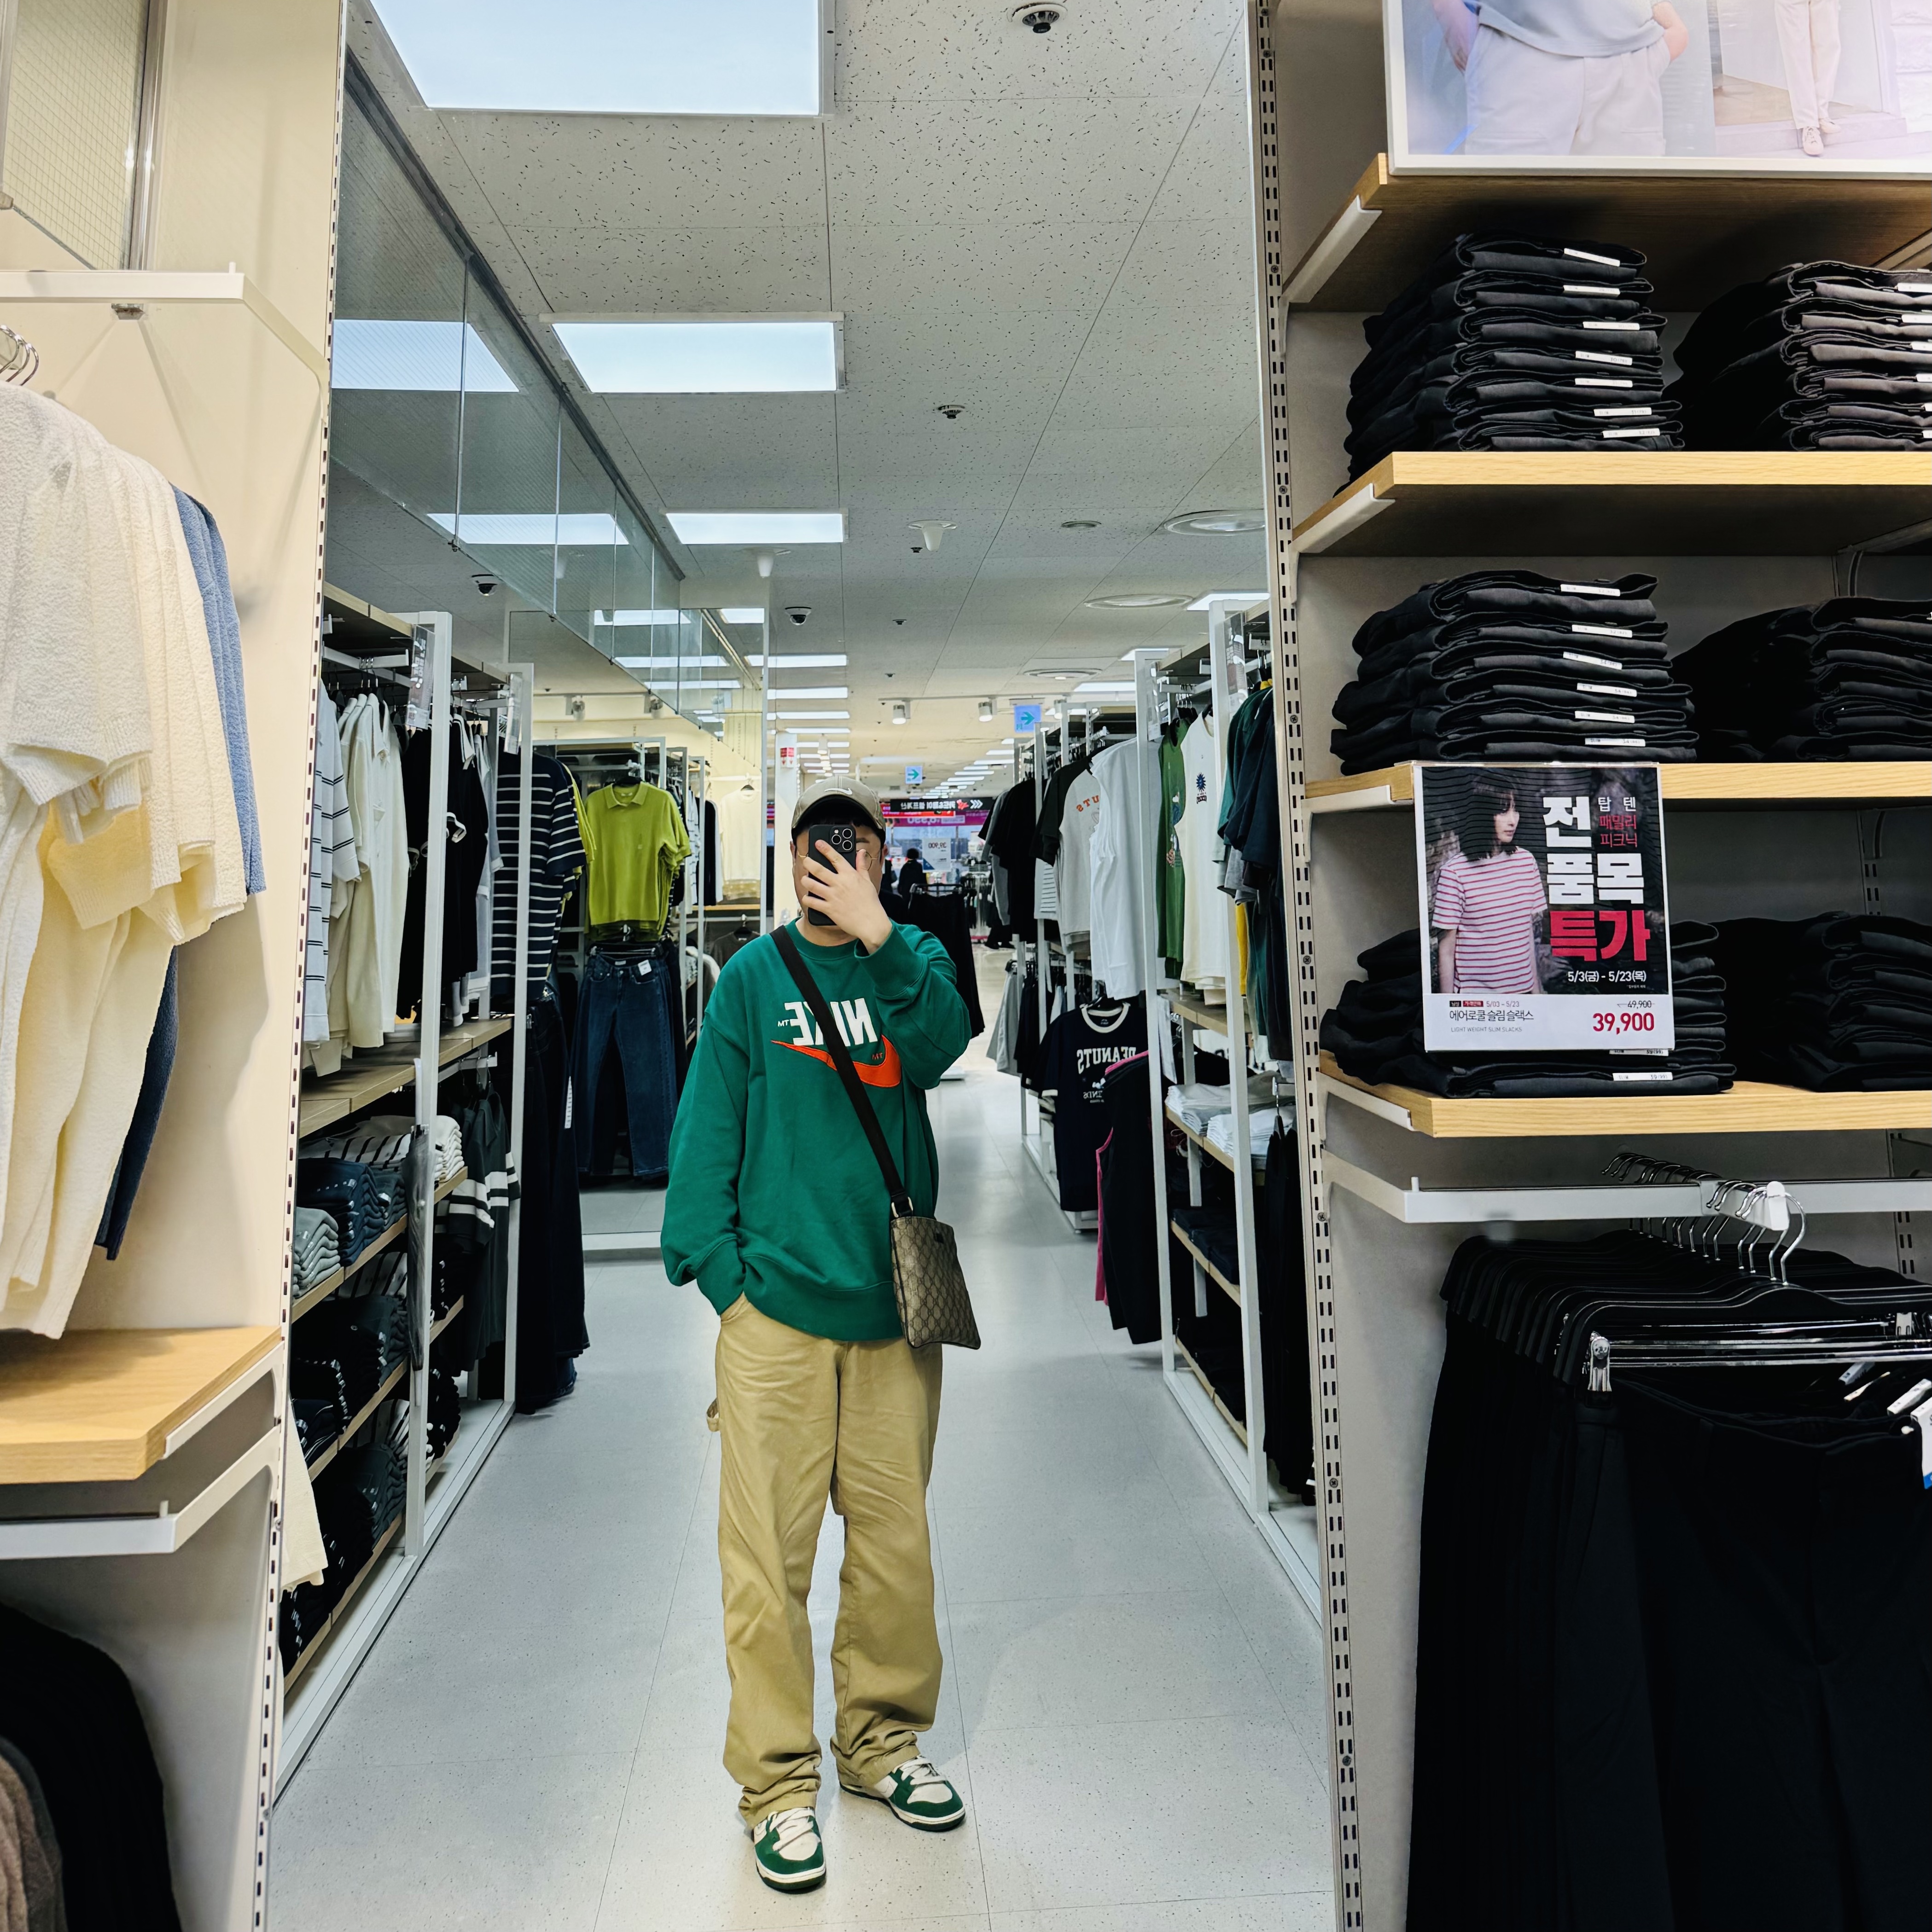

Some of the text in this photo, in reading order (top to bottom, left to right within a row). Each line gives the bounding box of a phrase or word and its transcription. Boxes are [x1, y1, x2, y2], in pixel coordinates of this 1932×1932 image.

[1598, 796, 1636, 812] 탑 텐
[1543, 796, 1592, 847] 전
[1599, 815, 1637, 830] 패밀리
[1600, 833, 1637, 847] 피크닉
[1547, 853, 1644, 904] 품목
[1549, 910, 1651, 961] 특가
[1568, 970, 1599, 982] 5/3(금)
[1608, 970, 1647, 982] 5/23(목)
[1628, 1000, 1652, 1009] 49,900
[1449, 1010, 1534, 1021] 에어로쿨 슬림 슬랙스
[1593, 1013, 1654, 1035] 39,900
